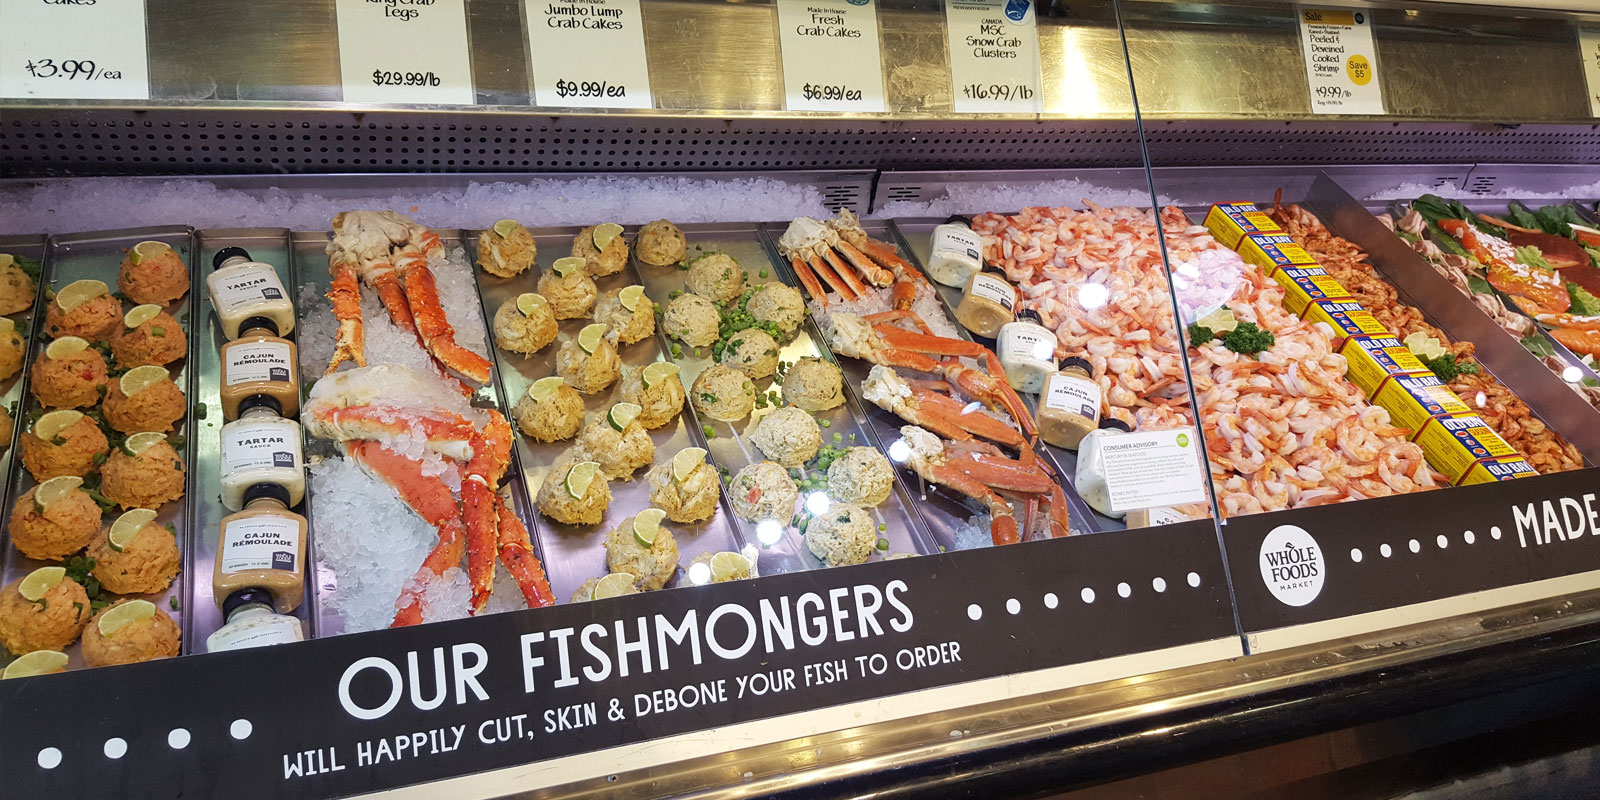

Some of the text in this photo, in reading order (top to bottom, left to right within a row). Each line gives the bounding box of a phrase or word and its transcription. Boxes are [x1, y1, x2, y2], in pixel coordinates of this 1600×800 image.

[385, 5, 419, 21] Legs
[544, 3, 623, 19] Jumbo Lump
[1305, 12, 1322, 21] Sale
[547, 16, 623, 30] Crab Cakes
[812, 14, 844, 25] Fresh
[797, 25, 861, 38] Crab Cakes
[980, 25, 1006, 36] MSC
[966, 36, 1021, 47] Snow Crab
[1310, 34, 1335, 43] Peeled
[973, 47, 1017, 58] Clusters
[1311, 44, 1345, 53] Deveined
[1312, 54, 1340, 63] Cooked
[25, 59, 122, 80] $3.99/ea
[1313, 63, 1340, 73] Shrimp
[1349, 60, 1368, 69] Save
[372, 69, 441, 87] $29.99/lb
[1355, 69, 1365, 78] $5
[556, 79, 626, 98] $9.99/ea
[803, 83, 862, 101] $6.99/ea
[963, 84, 1033, 101] $16.99/lb
[1221, 206, 1241, 214] OLD
[946, 234, 975, 246] TARTAR
[1252, 236, 1275, 245] OLD
[1286, 269, 1309, 278] OLD
[227, 278, 267, 290] TARTAR
[1321, 303, 1363, 313] OLD BAY
[1360, 338, 1401, 349] OLD BAY
[1400, 378, 1424, 388] OLD
[1419, 376, 1441, 386] BAY
[1063, 385, 1088, 396] CAJUN
[1442, 417, 1487, 430] OLD BAY
[237, 437, 284, 446] TARTAR
[1103, 441, 1158, 452] CONSUMER ADVISORY
[1487, 463, 1513, 476] OLD
[1507, 461, 1532, 473] BAY
[1513, 493, 1600, 548] MADE
[1264, 544, 1317, 567] WHOLE
[1271, 562, 1318, 582] FOODS
[1280, 580, 1313, 591] MARKET
[337, 579, 914, 720] OUR FISHMONGERS
[283, 641, 963, 780] WILL HAPPILY CUT, SKIN & DEBONE YOUR FISH TO ORDER
